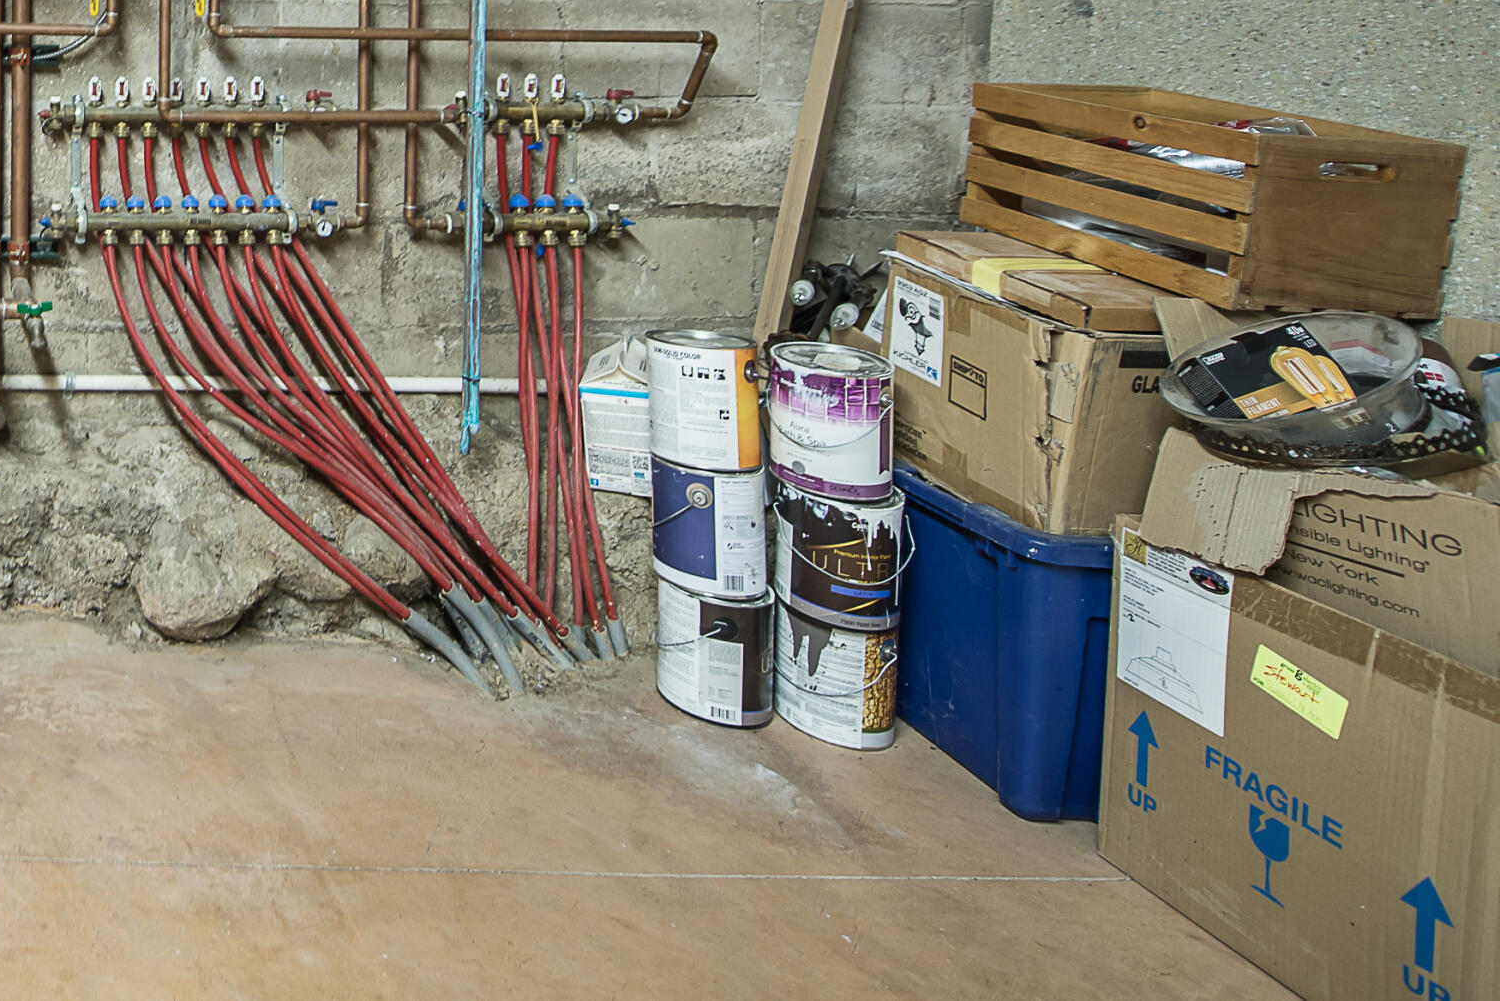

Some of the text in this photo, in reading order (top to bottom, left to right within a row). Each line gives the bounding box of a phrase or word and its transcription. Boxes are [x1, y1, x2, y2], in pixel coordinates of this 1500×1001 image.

[1328, 559, 1380, 587] York
[1263, 664, 1320, 704] Stewart
[1127, 783, 1158, 814] UP
[1205, 744, 1344, 850] FRAGILE
[1403, 965, 1451, 1001] UP
